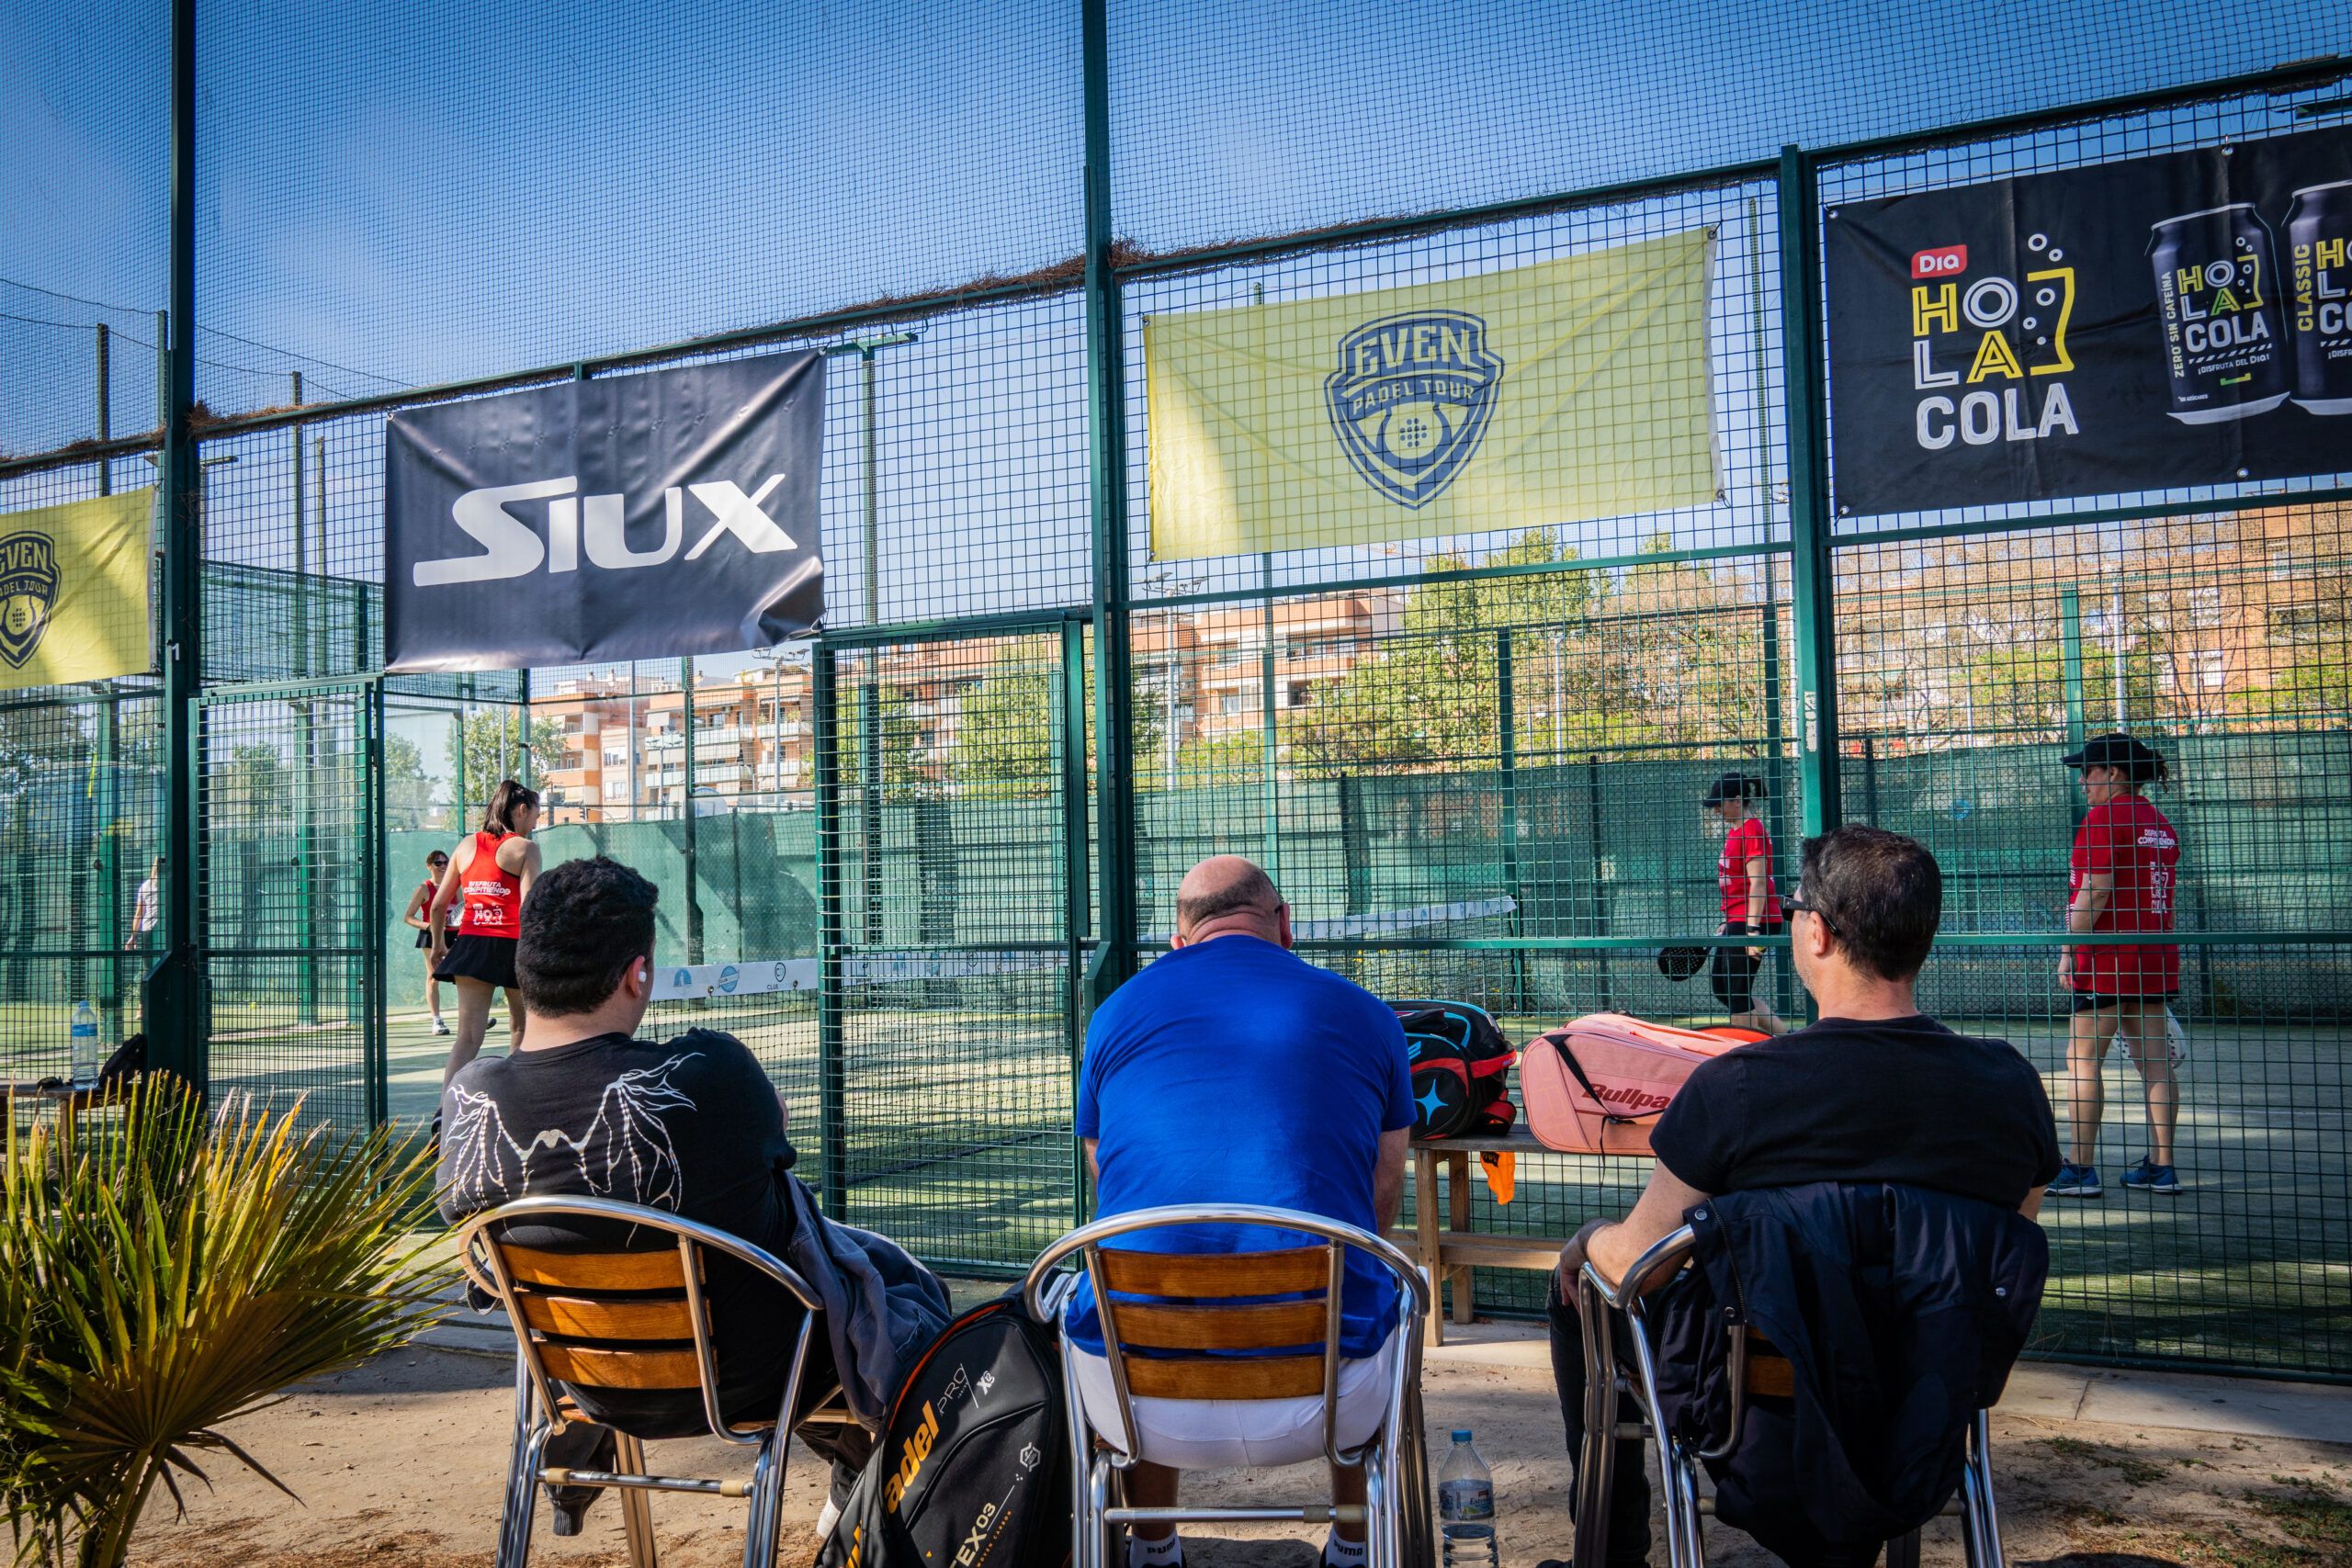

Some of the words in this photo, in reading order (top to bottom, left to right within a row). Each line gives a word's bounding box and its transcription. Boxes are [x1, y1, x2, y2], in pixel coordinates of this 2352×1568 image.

[2161, 271, 2177, 320] CAFEÍNA
[2294, 243, 2314, 332] CLASSIC
[1344, 325, 1484, 385] EVEN
[2168, 322, 2180, 343] SIN
[2185, 310, 2270, 353] COLA
[2235, 358, 2249, 367] DEL
[1352, 381, 1415, 415] PADEL
[1420, 379, 1474, 400] TOUR
[1916, 382, 2079, 450] COLA
[413, 473, 798, 587] SIUX
